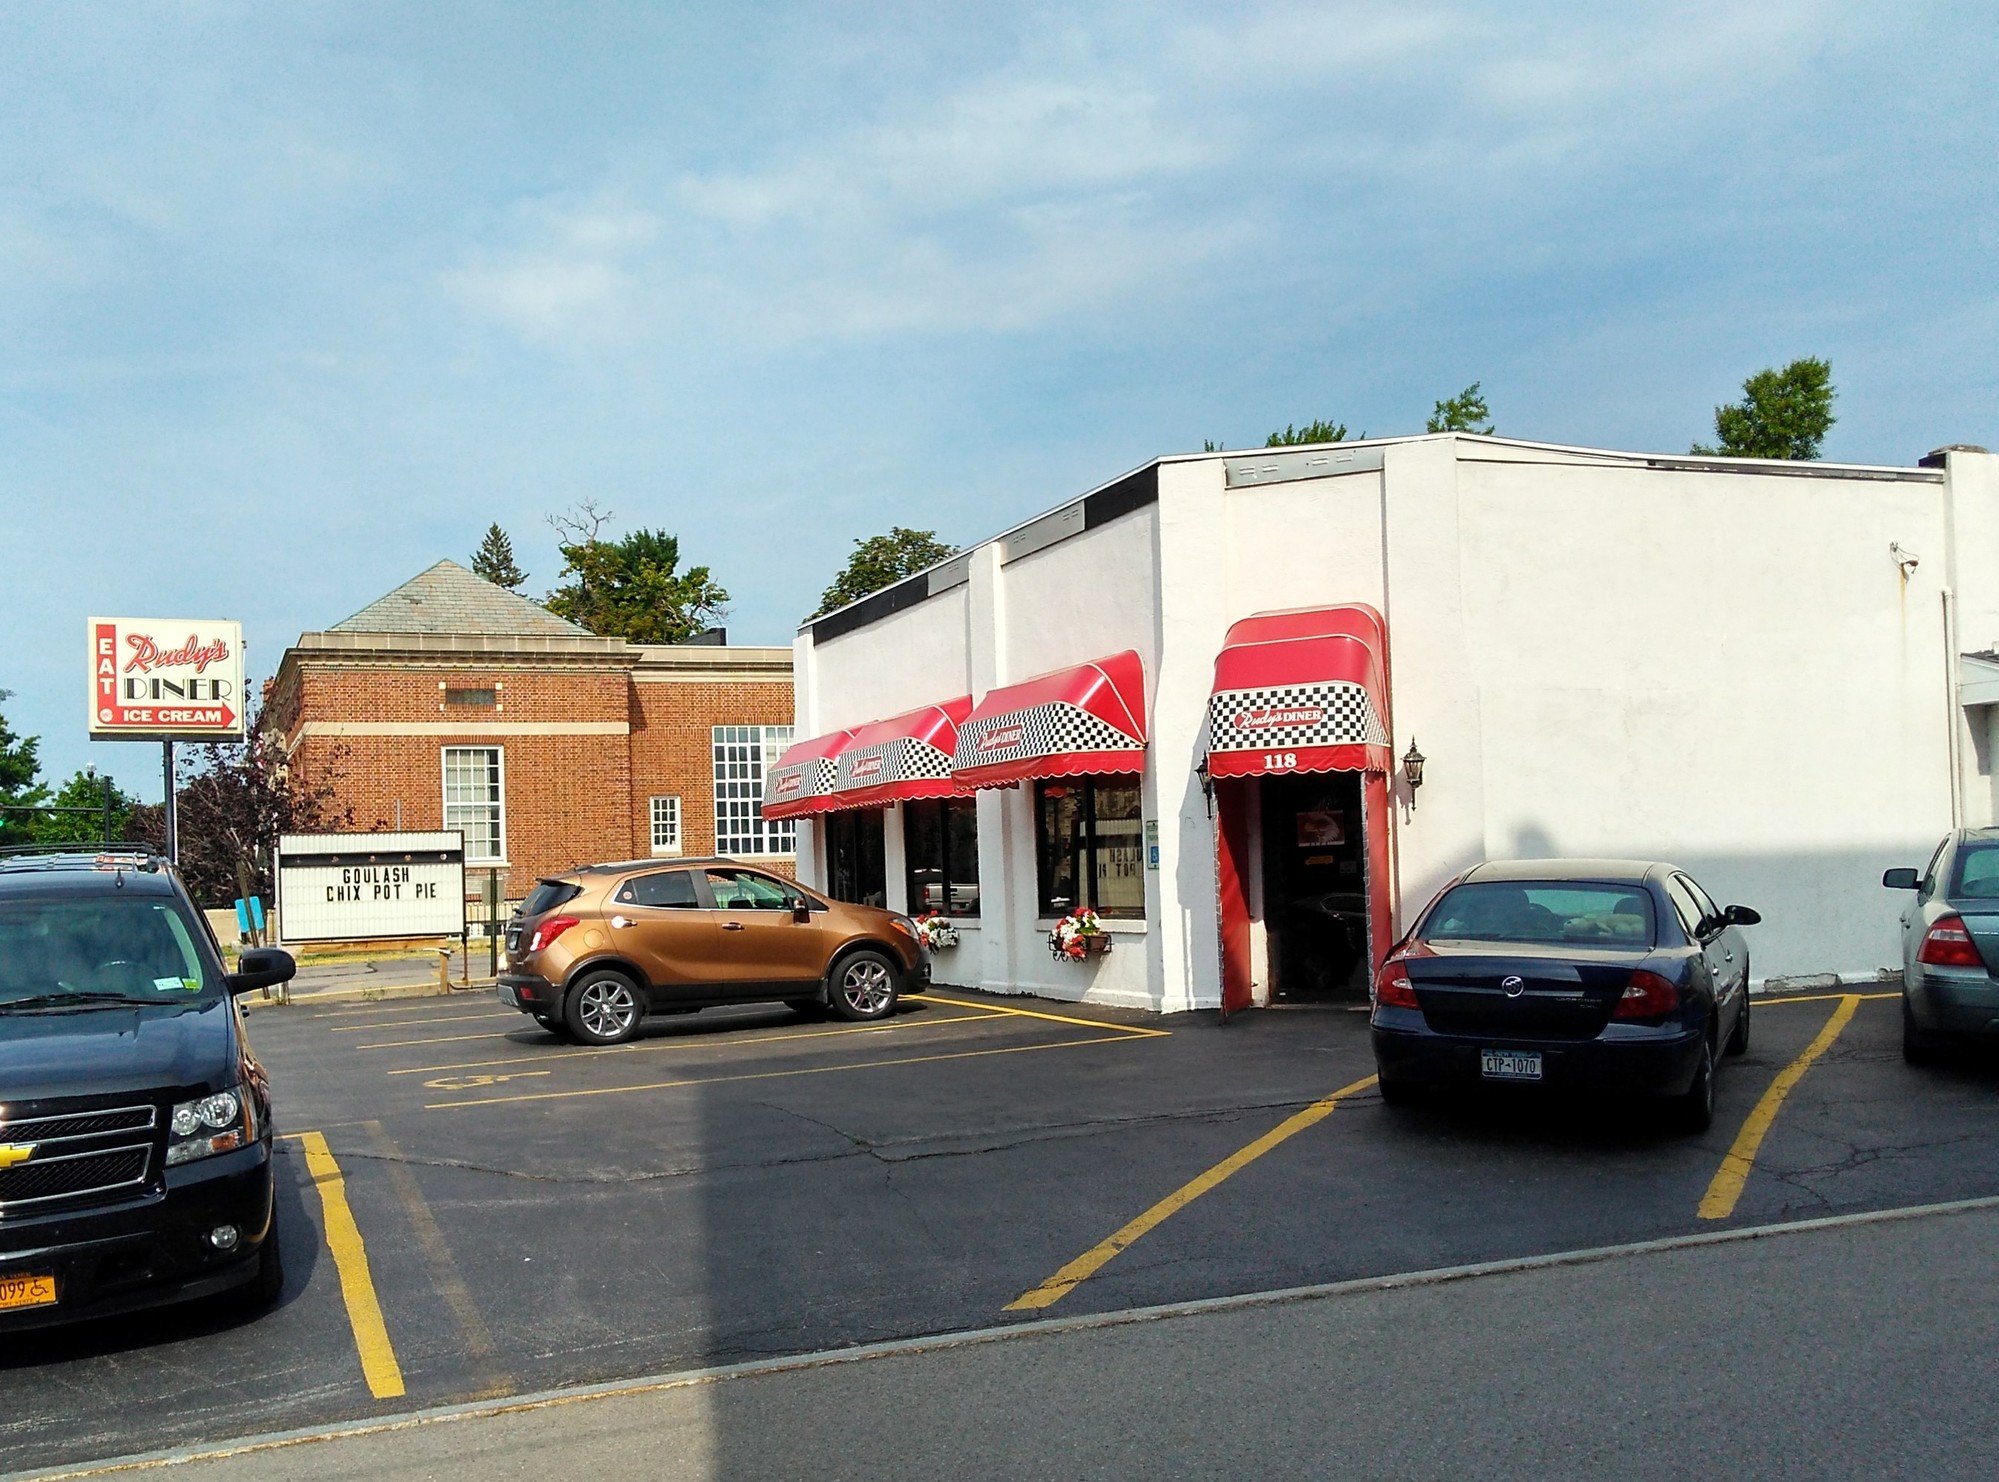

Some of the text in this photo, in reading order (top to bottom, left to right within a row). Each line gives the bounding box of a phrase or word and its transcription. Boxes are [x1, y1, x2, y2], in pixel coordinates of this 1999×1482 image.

[124, 633, 229, 673] Rudy's
[99, 638, 115, 695] EAT
[124, 678, 232, 701] DINER
[123, 709, 153, 722] ICE
[157, 709, 222, 722] CREAM
[1240, 710, 1322, 729] Rudy's DINER
[1001, 728, 1021, 744] DINER
[1263, 752, 1297, 770] 118
[343, 867, 410, 884] GOULASH
[326, 883, 437, 902] CHIX POT PIE
[0, 1281, 25, 1301] 099
